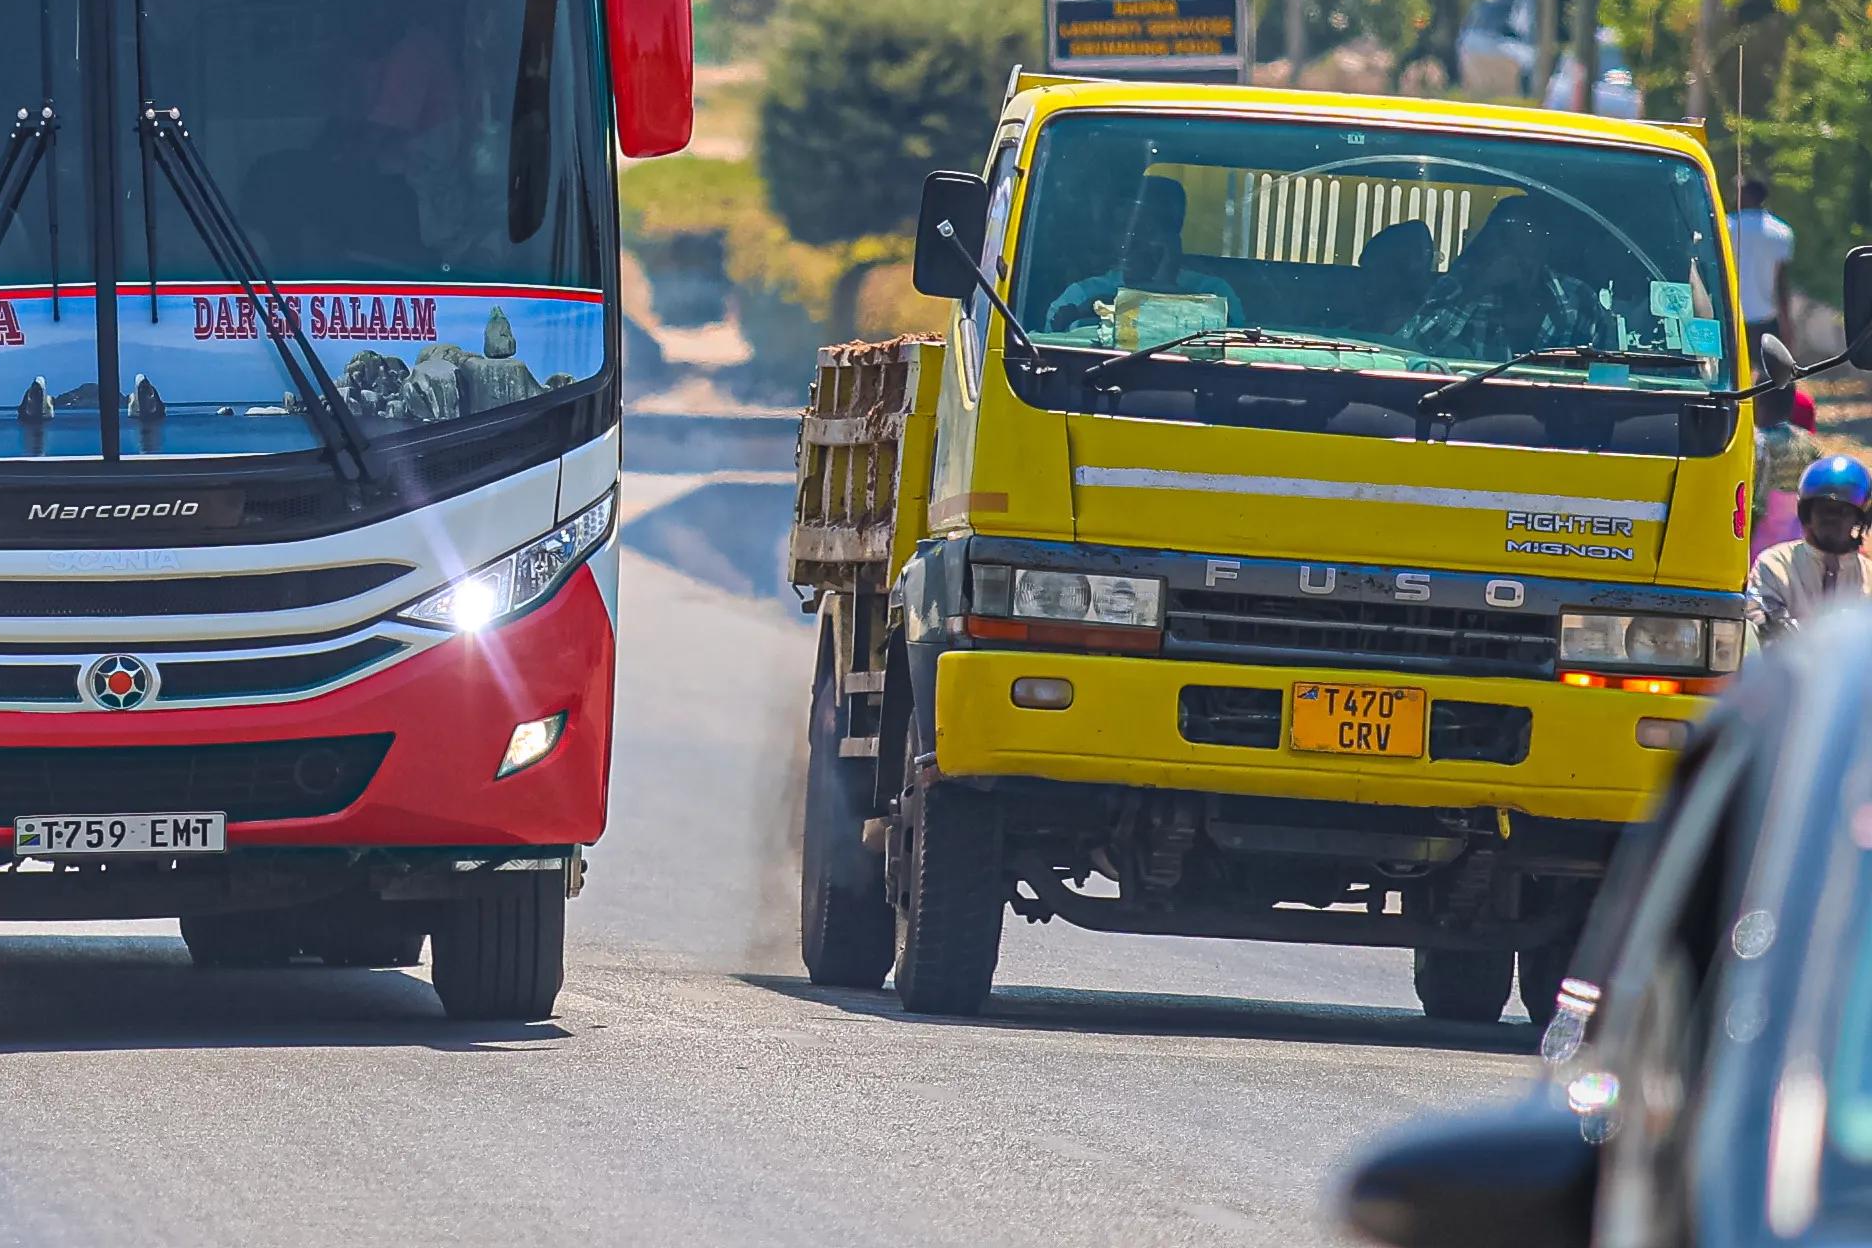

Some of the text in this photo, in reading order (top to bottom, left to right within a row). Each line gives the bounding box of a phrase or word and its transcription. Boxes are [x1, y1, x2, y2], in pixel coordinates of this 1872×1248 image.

[193, 296, 258, 340] DAR
[311, 295, 437, 341] SALAAM
[28, 499, 199, 521] Marcopolo
[1506, 510, 1633, 538] FIGHTER
[1506, 539, 1633, 561] MIGNON
[1204, 558, 1526, 609] FUSO
[1324, 687, 1394, 719] T470
[1338, 721, 1391, 751] CRV
[40, 818, 213, 849] T759 EMT
